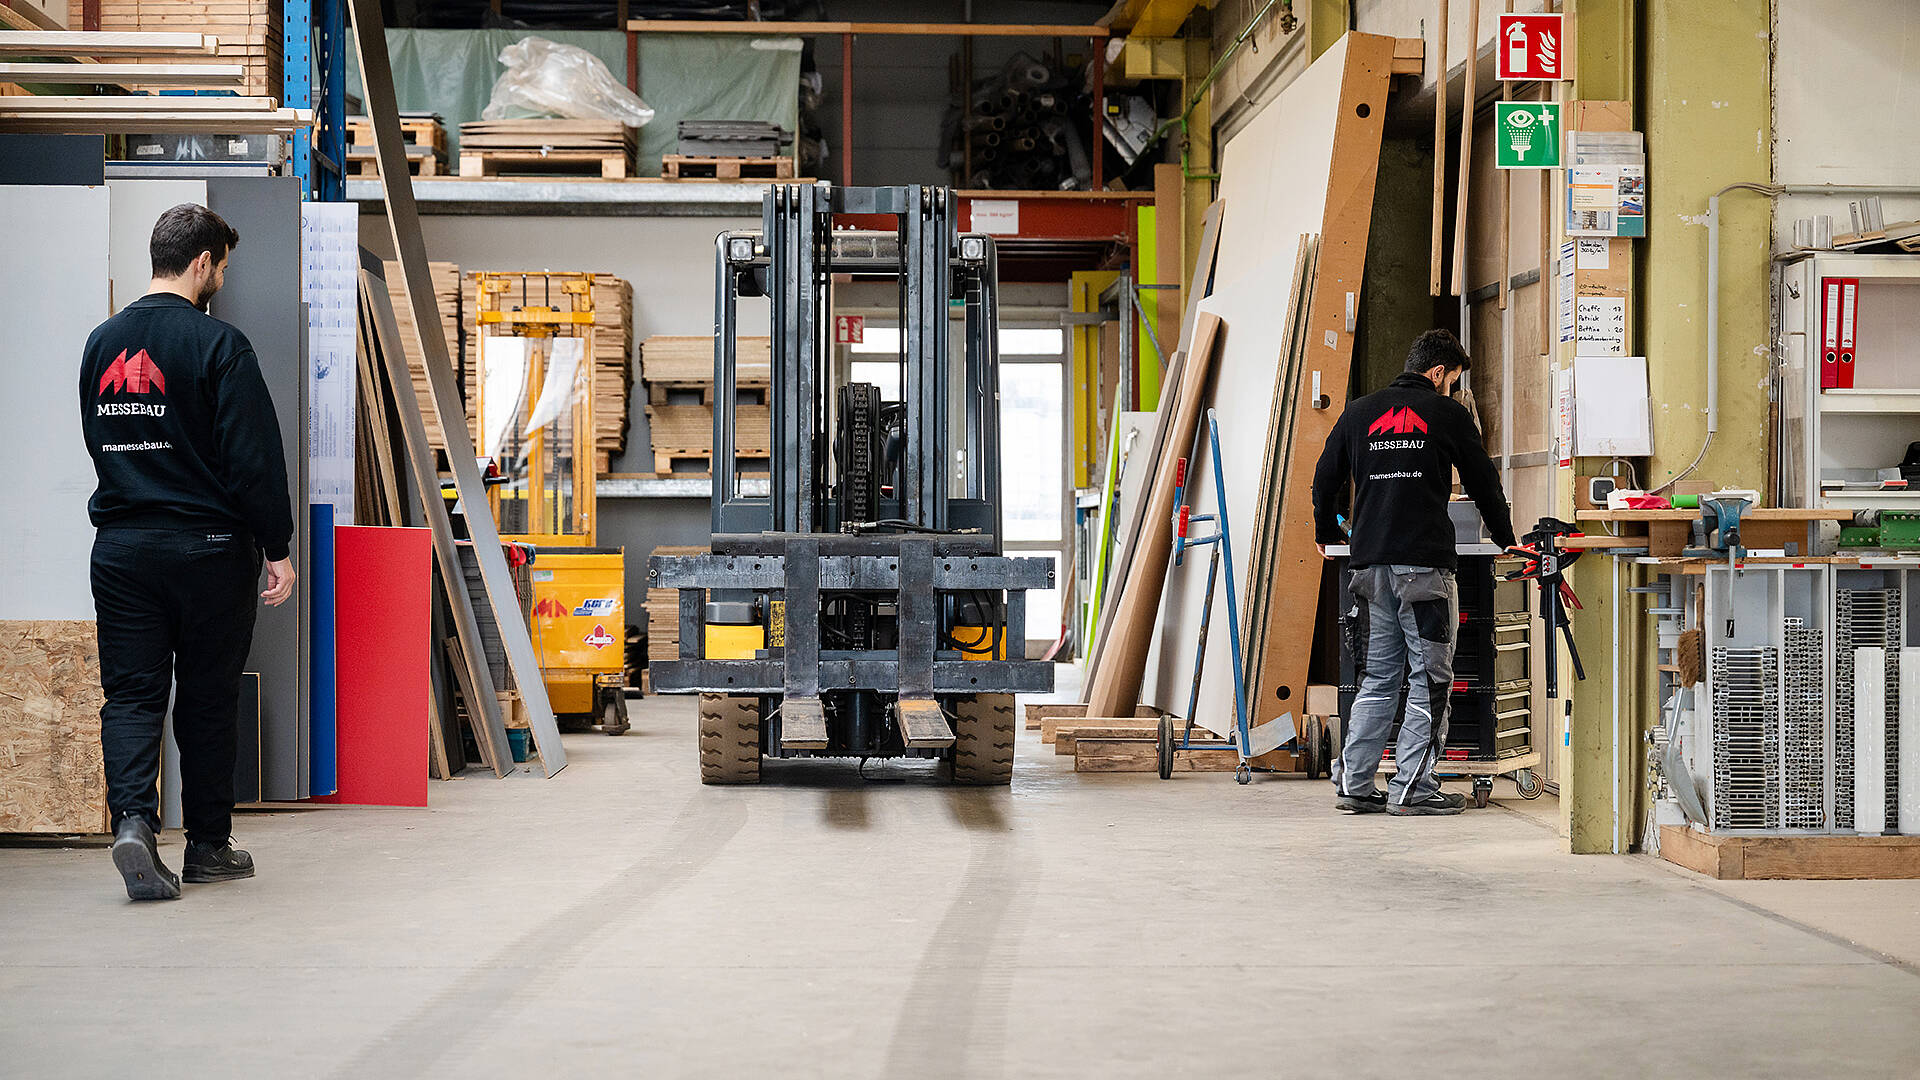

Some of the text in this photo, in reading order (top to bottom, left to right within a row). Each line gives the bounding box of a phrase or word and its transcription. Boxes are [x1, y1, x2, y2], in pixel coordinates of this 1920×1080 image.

[1614, 325, 1624, 333] 20
[96, 402, 167, 418] MESSEBAU
[1369, 440, 1426, 451] MESSEBAU
[1369, 470, 1423, 481] mamessebau.de
